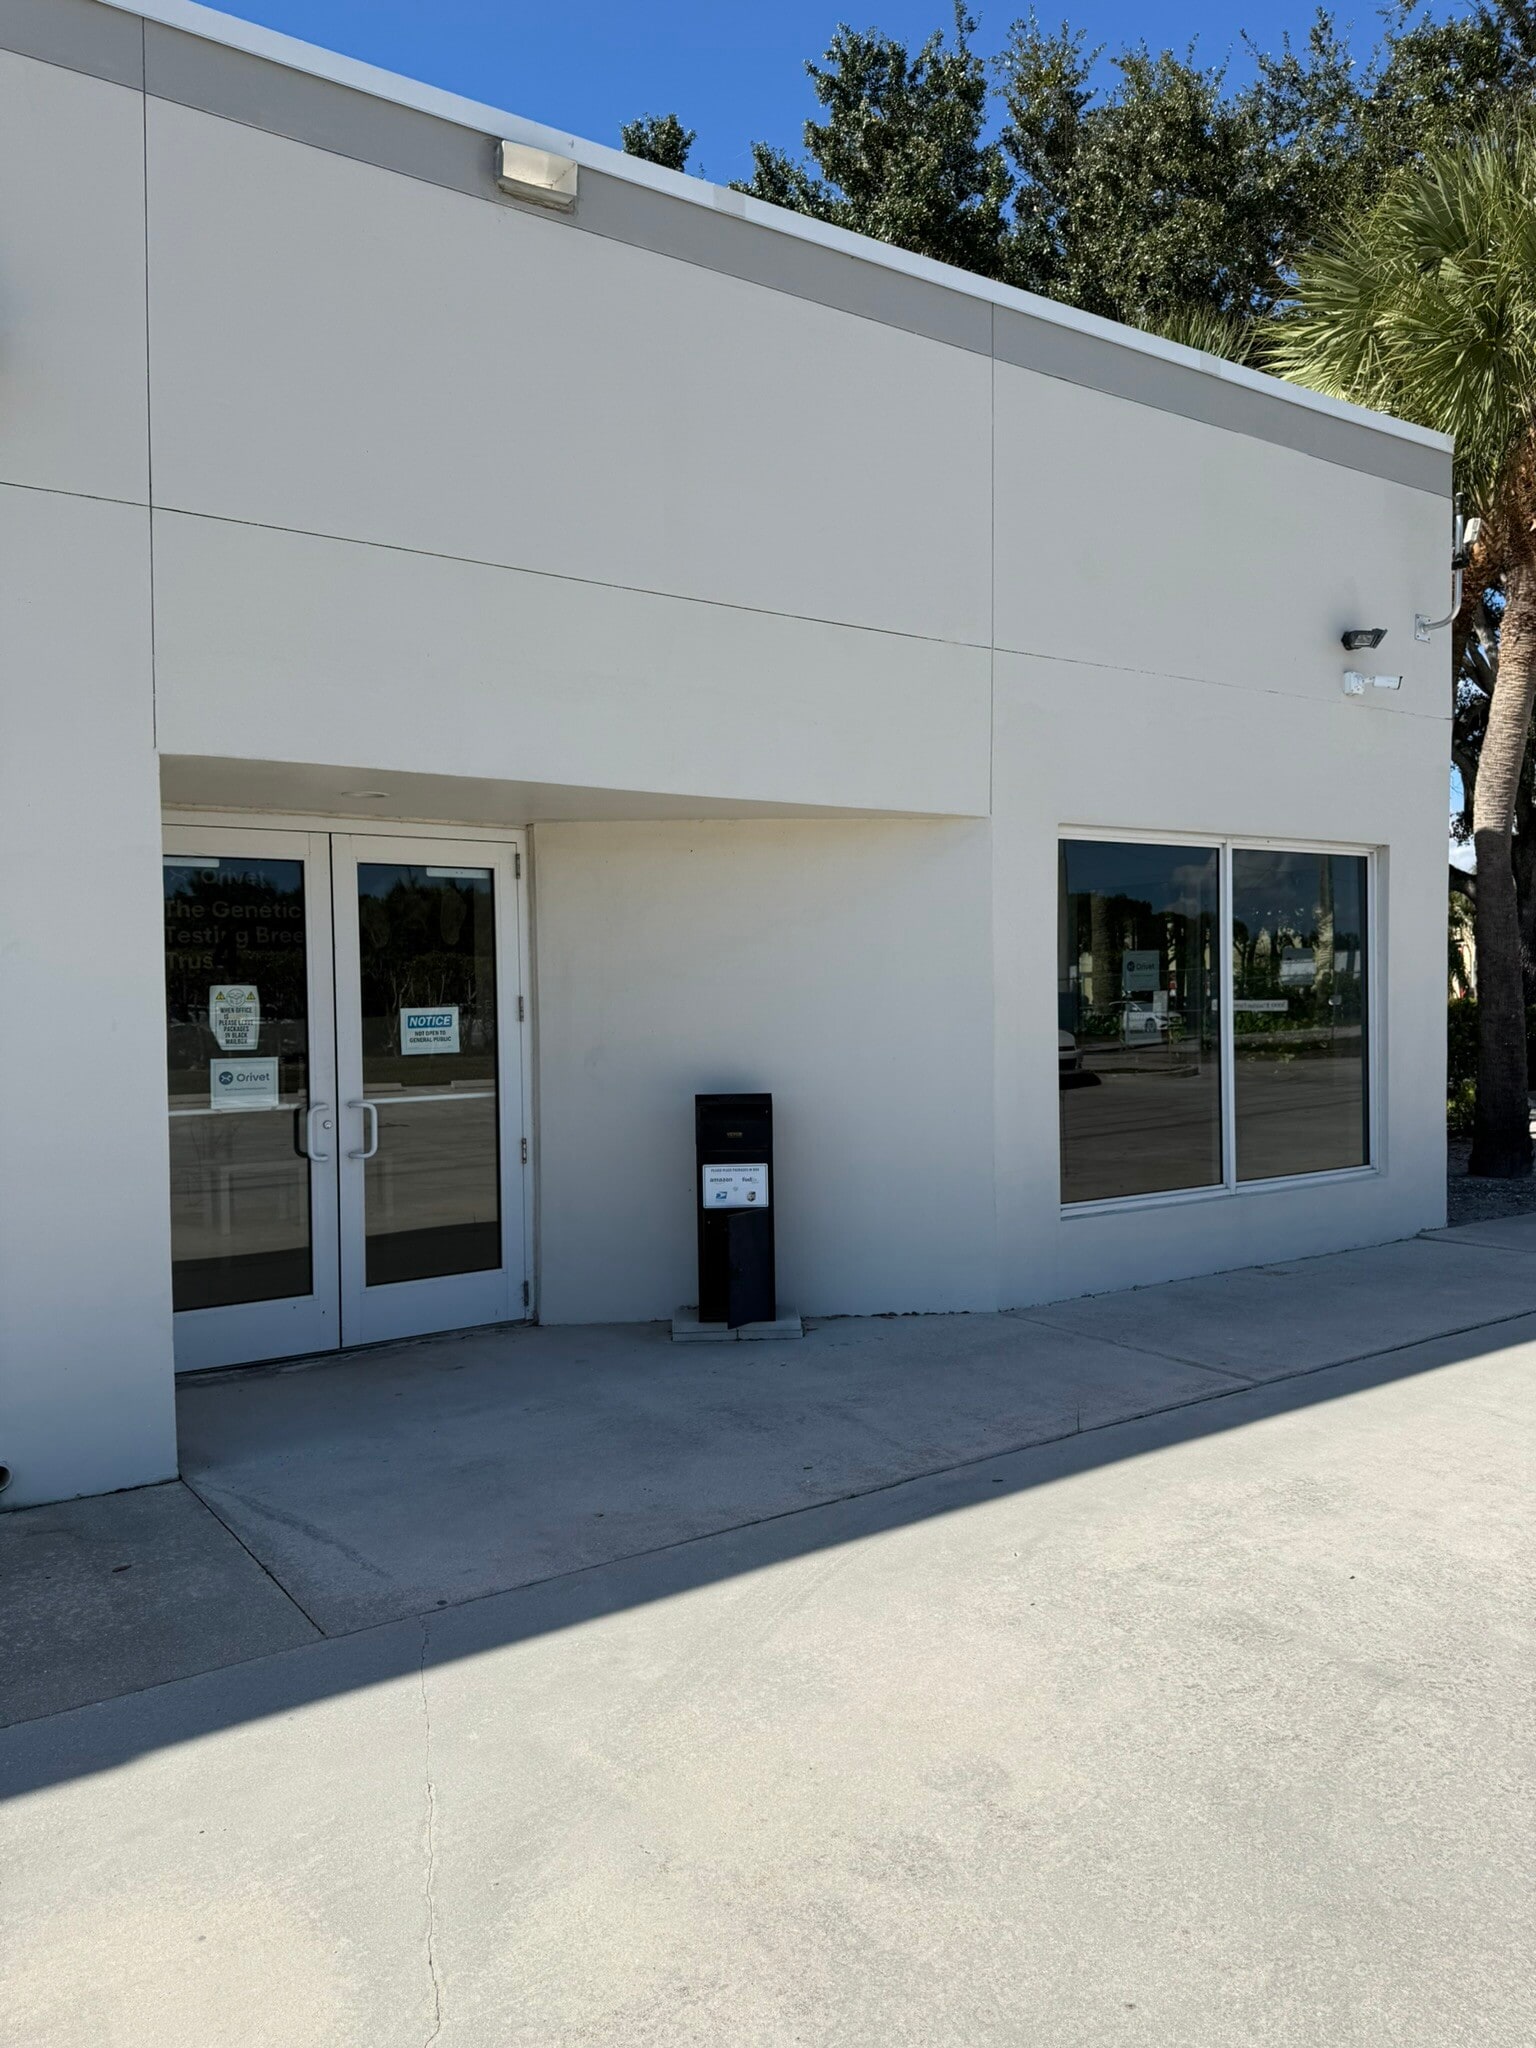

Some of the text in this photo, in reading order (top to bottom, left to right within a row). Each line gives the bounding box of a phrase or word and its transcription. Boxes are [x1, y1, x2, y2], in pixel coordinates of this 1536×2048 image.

[200, 868, 266, 887] Orivet
[166, 899, 302, 919] The Genetic
[166, 952, 224, 969] Trus
[409, 1016, 451, 1027] NOTICE
[236, 1072, 270, 1082] Orivet
